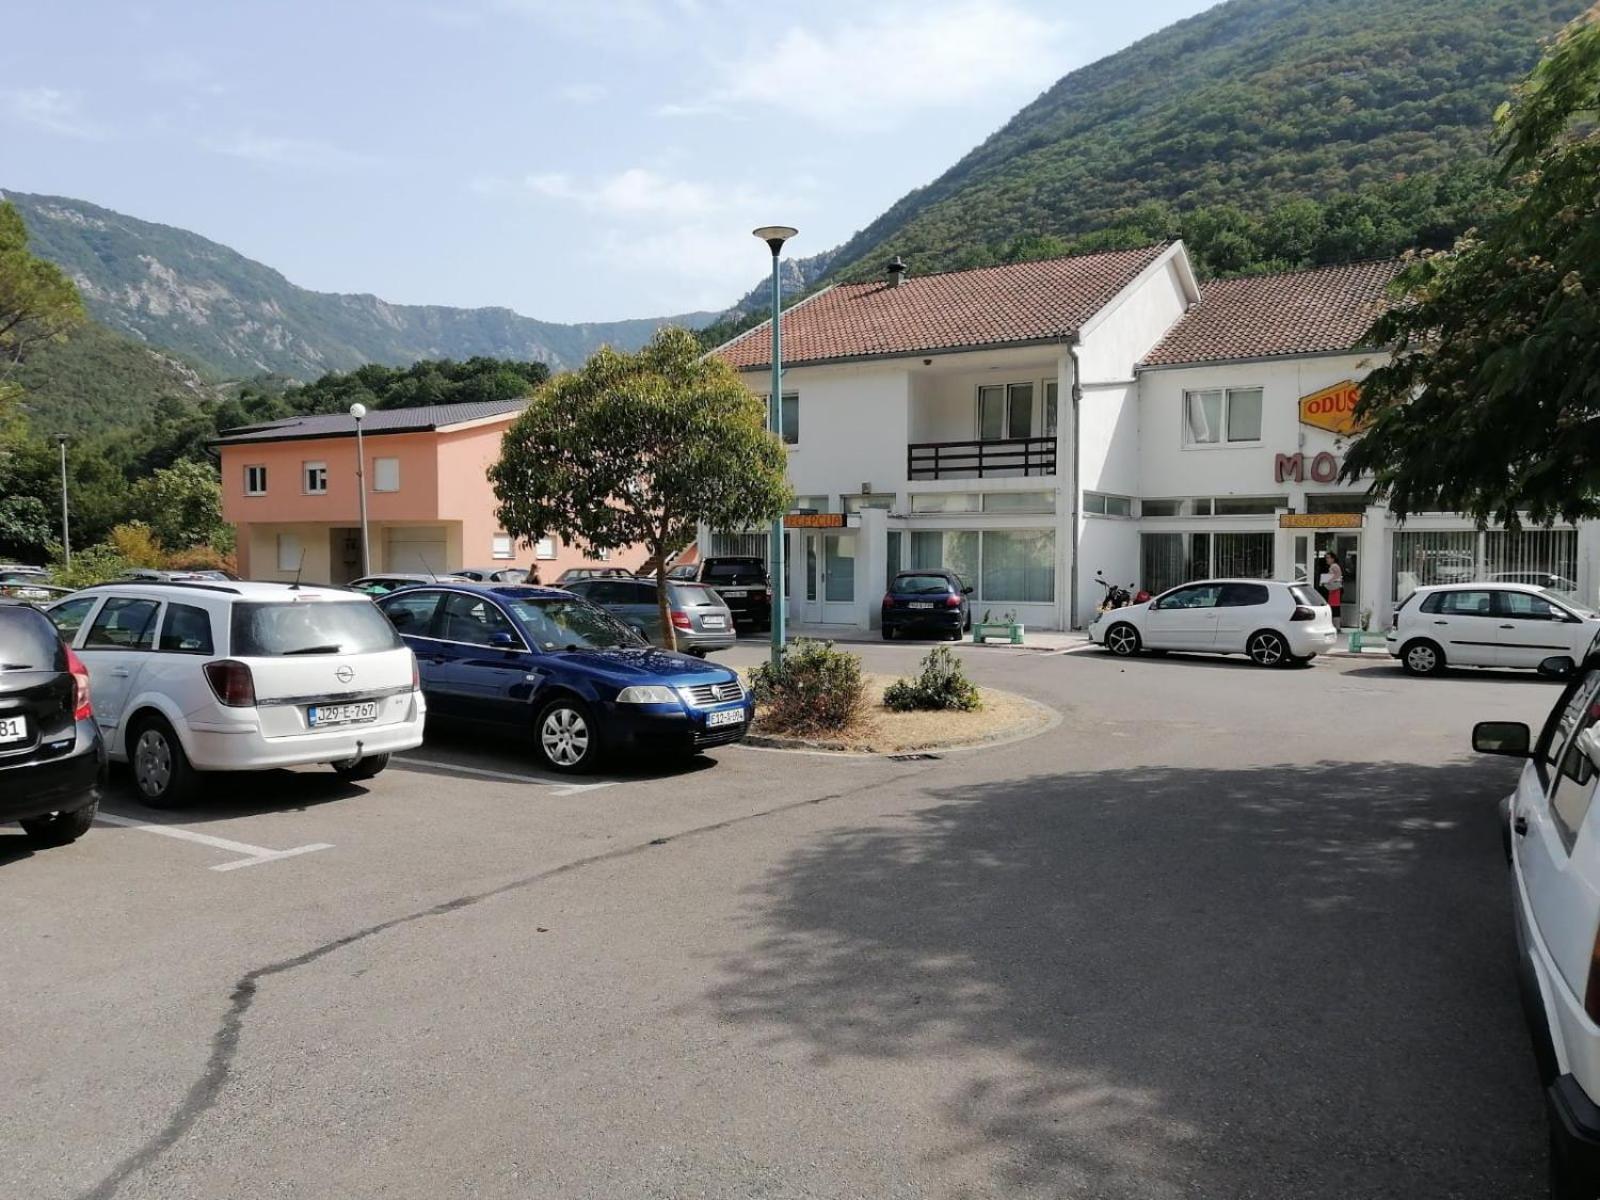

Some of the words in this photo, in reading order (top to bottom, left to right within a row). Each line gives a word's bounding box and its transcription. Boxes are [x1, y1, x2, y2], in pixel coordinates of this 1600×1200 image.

[1308, 389, 1358, 414] ODUS
[1275, 451, 1337, 483] MO
[1282, 515, 1361, 527] RESTORAN
[318, 704, 374, 721] J29-E-767
[0, 720, 20, 737] 81
